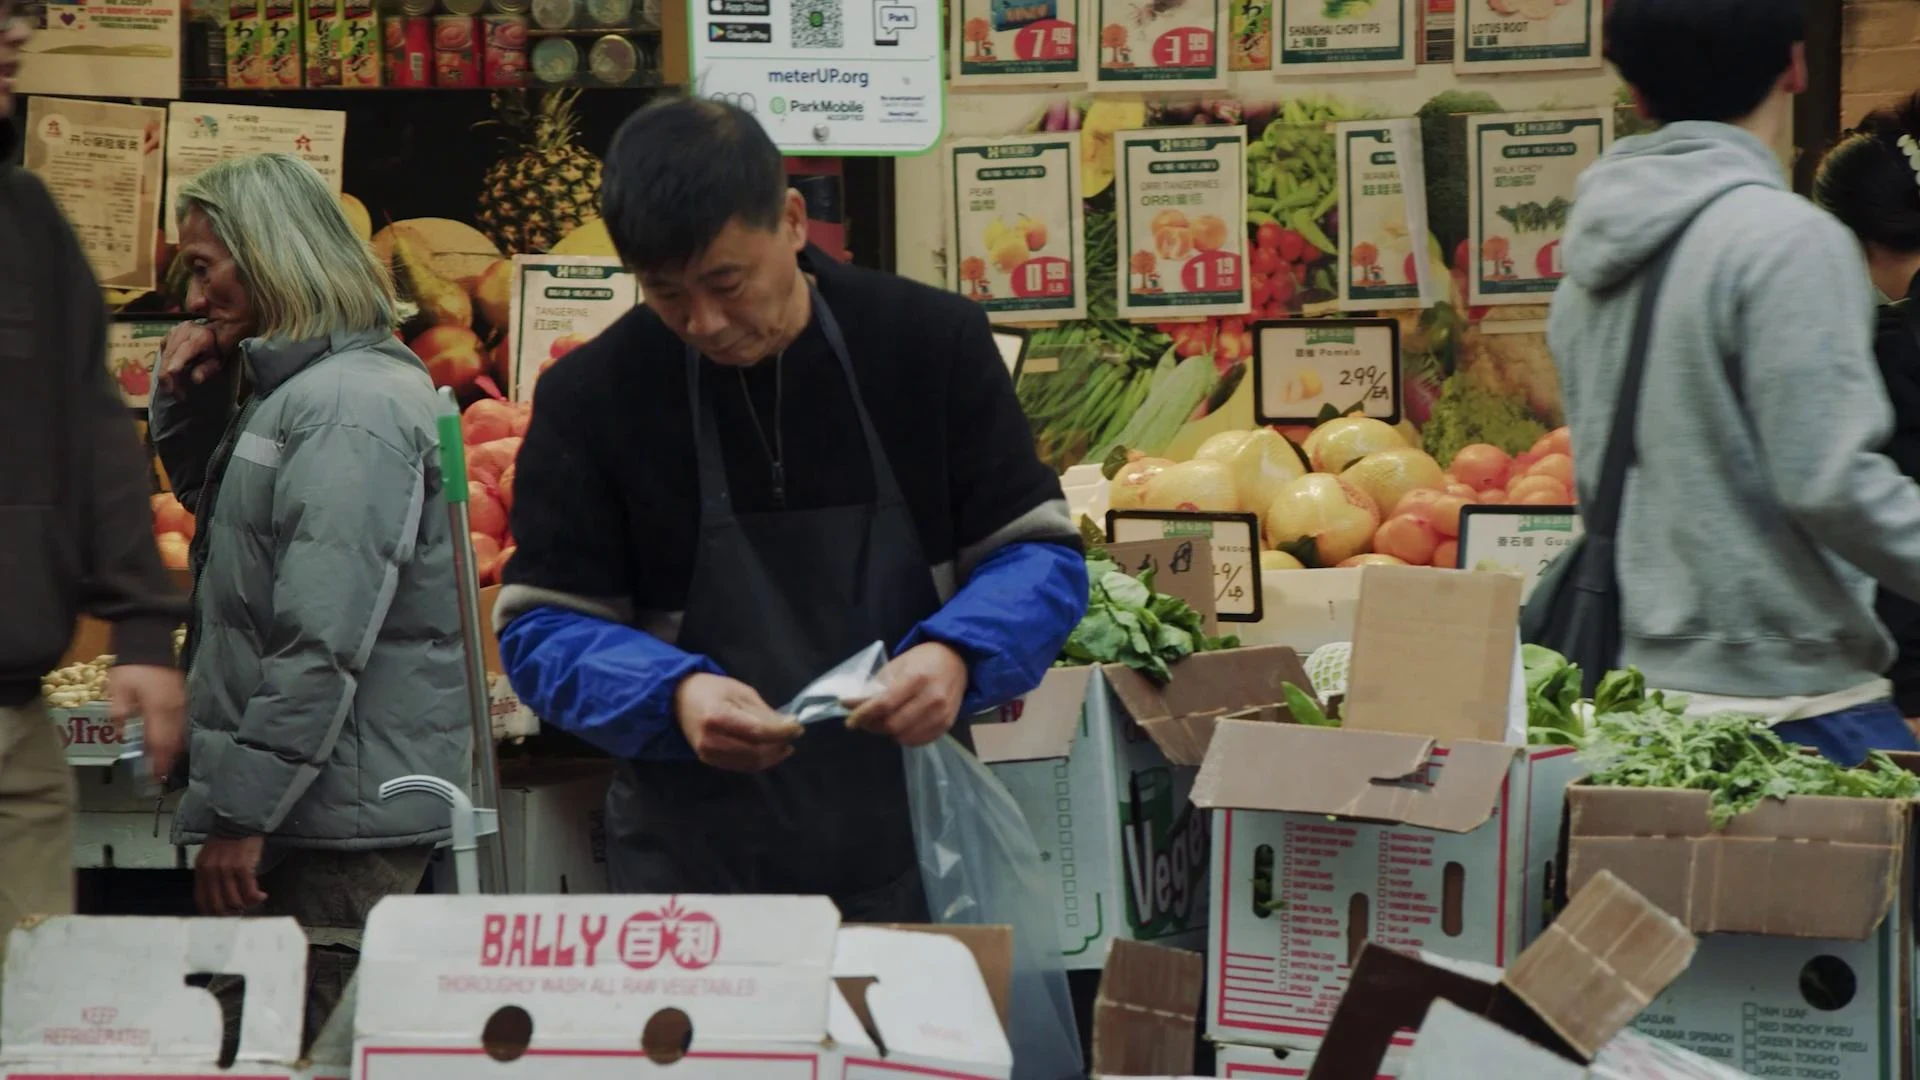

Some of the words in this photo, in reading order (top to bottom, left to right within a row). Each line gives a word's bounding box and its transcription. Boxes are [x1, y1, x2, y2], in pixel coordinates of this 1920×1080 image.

[742, 3, 768, 12] Store
[888, 13, 910, 21] Park
[1289, 25, 1333, 36] SHANGHAI
[1336, 23, 1358, 35] CHOY
[1361, 23, 1381, 34] TIPS
[1472, 23, 1501, 34] LOTUS
[1503, 22, 1529, 33] ROOT
[726, 31, 754, 41] Google
[755, 31, 769, 41] Play
[1030, 29, 1046, 58] 7
[1164, 35, 1182, 64] 3
[768, 69, 870, 87] meterUP.org
[790, 100, 864, 113] ParkMobile
[969, 188, 994, 196] PEAR
[1192, 262, 1206, 289] 1
[1319, 348, 1361, 357] Pomelo
[480, 914, 608, 966] BALLY
[623, 918, 717, 965] 百利
[437, 975, 536, 994] THOROUGHLY
[541, 976, 587, 994] WASH
[589, 976, 616, 995] ALL
[621, 977, 657, 995] RAW
[661, 977, 757, 997] VEGETABLES
[82, 1006, 119, 1025] KEEP
[1758, 1007, 1780, 1016] YAM
[1782, 1008, 1808, 1019] LEAF
[1758, 1022, 1780, 1032] RED
[43, 1027, 151, 1046] REFRIGERATED
[1688, 1030, 1735, 1043] SPINACH
[1758, 1036, 1793, 1047] GREEN
[1758, 1051, 1792, 1062] SMALL
[1794, 1052, 1840, 1066] TONGHO
[1758, 1065, 1792, 1077] LARGE
[1794, 1067, 1840, 1080] TONGHO
